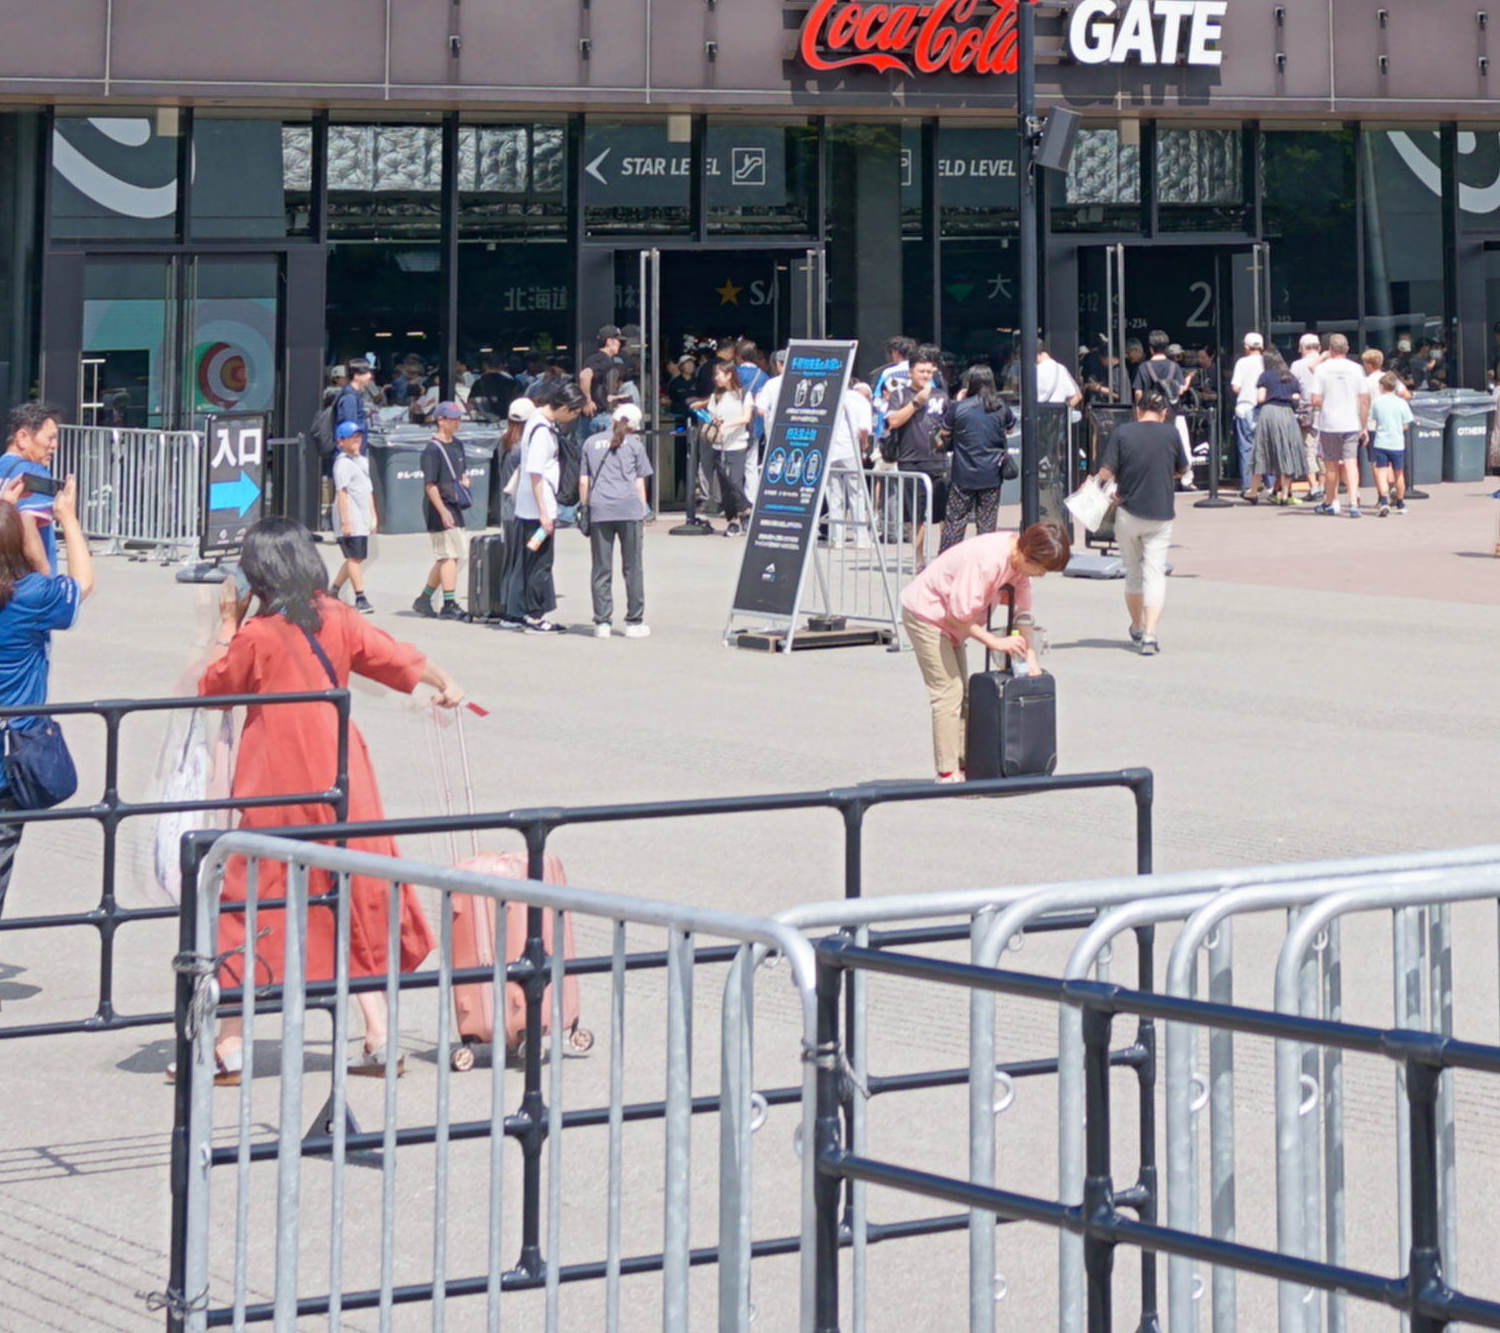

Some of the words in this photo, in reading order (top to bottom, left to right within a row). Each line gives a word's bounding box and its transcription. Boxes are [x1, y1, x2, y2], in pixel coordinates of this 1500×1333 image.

[621, 157, 666, 176] STAR
[670, 158, 721, 176] LEEL
[970, 160, 1016, 177] LEVEL
[211, 428, 261, 469] 入口
